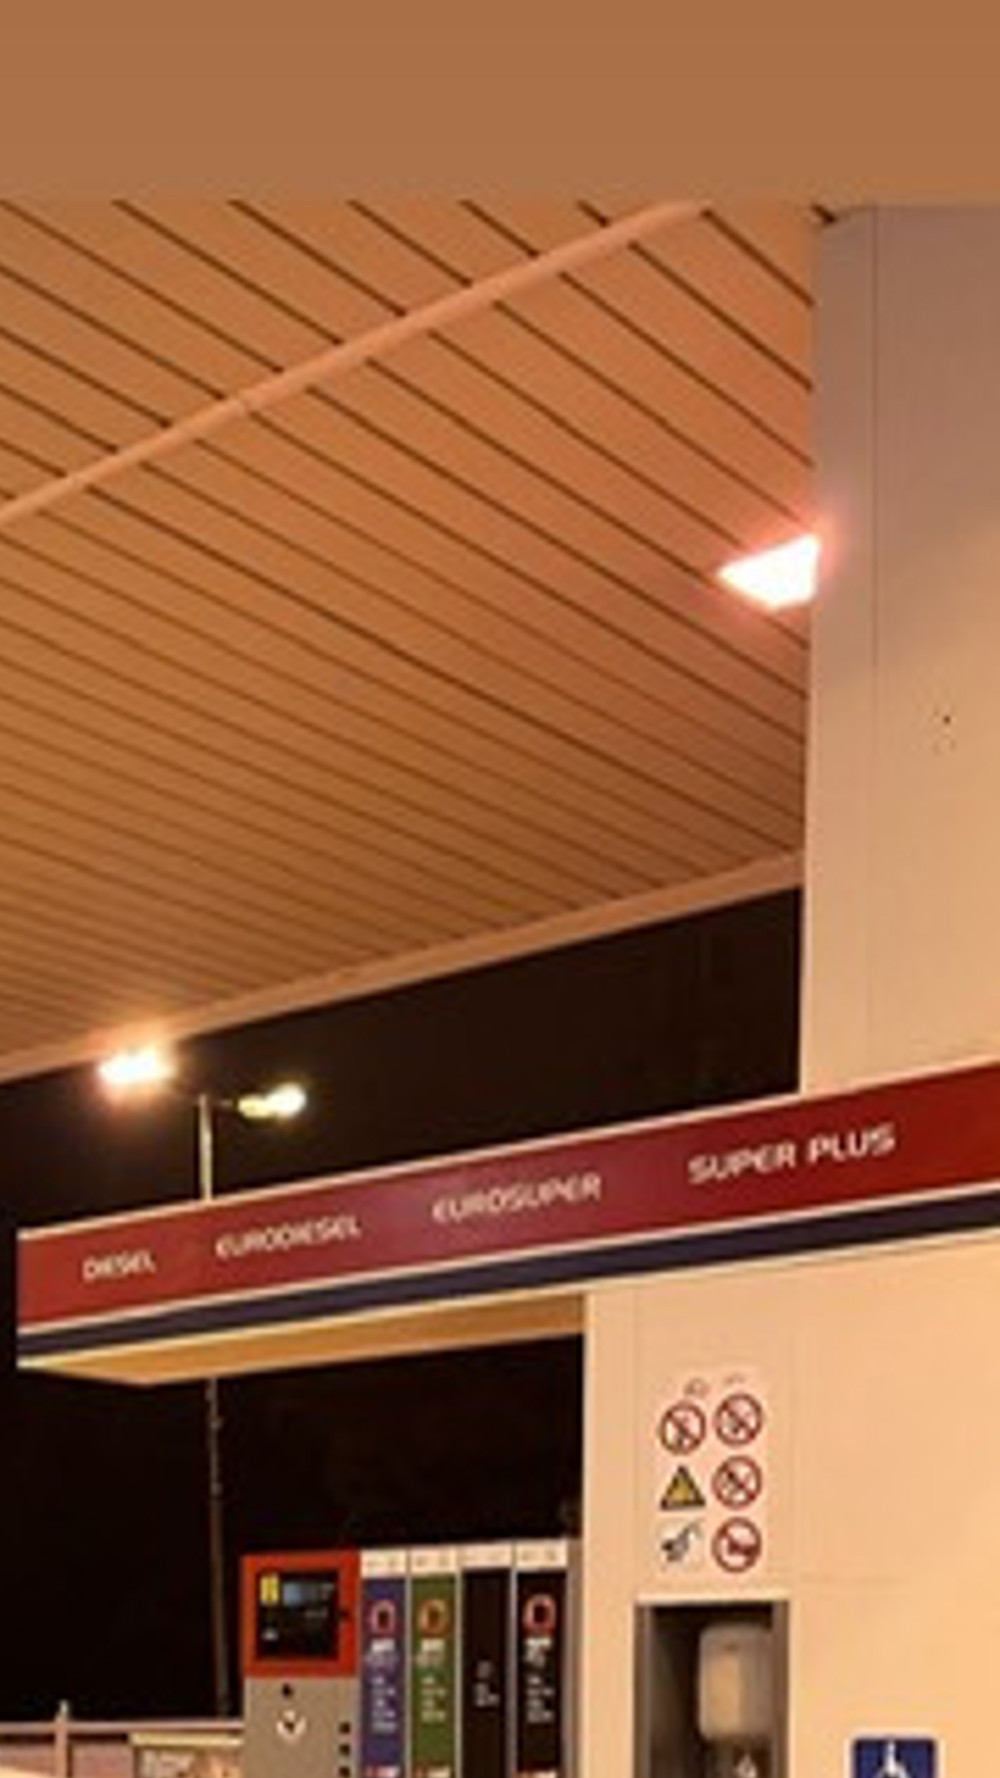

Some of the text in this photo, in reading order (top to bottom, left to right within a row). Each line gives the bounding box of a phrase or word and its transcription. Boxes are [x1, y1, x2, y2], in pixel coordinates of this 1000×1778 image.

[82, 1122, 896, 1282] DIESEL EURODIESEL EUROSUPER SUPER PLUS
